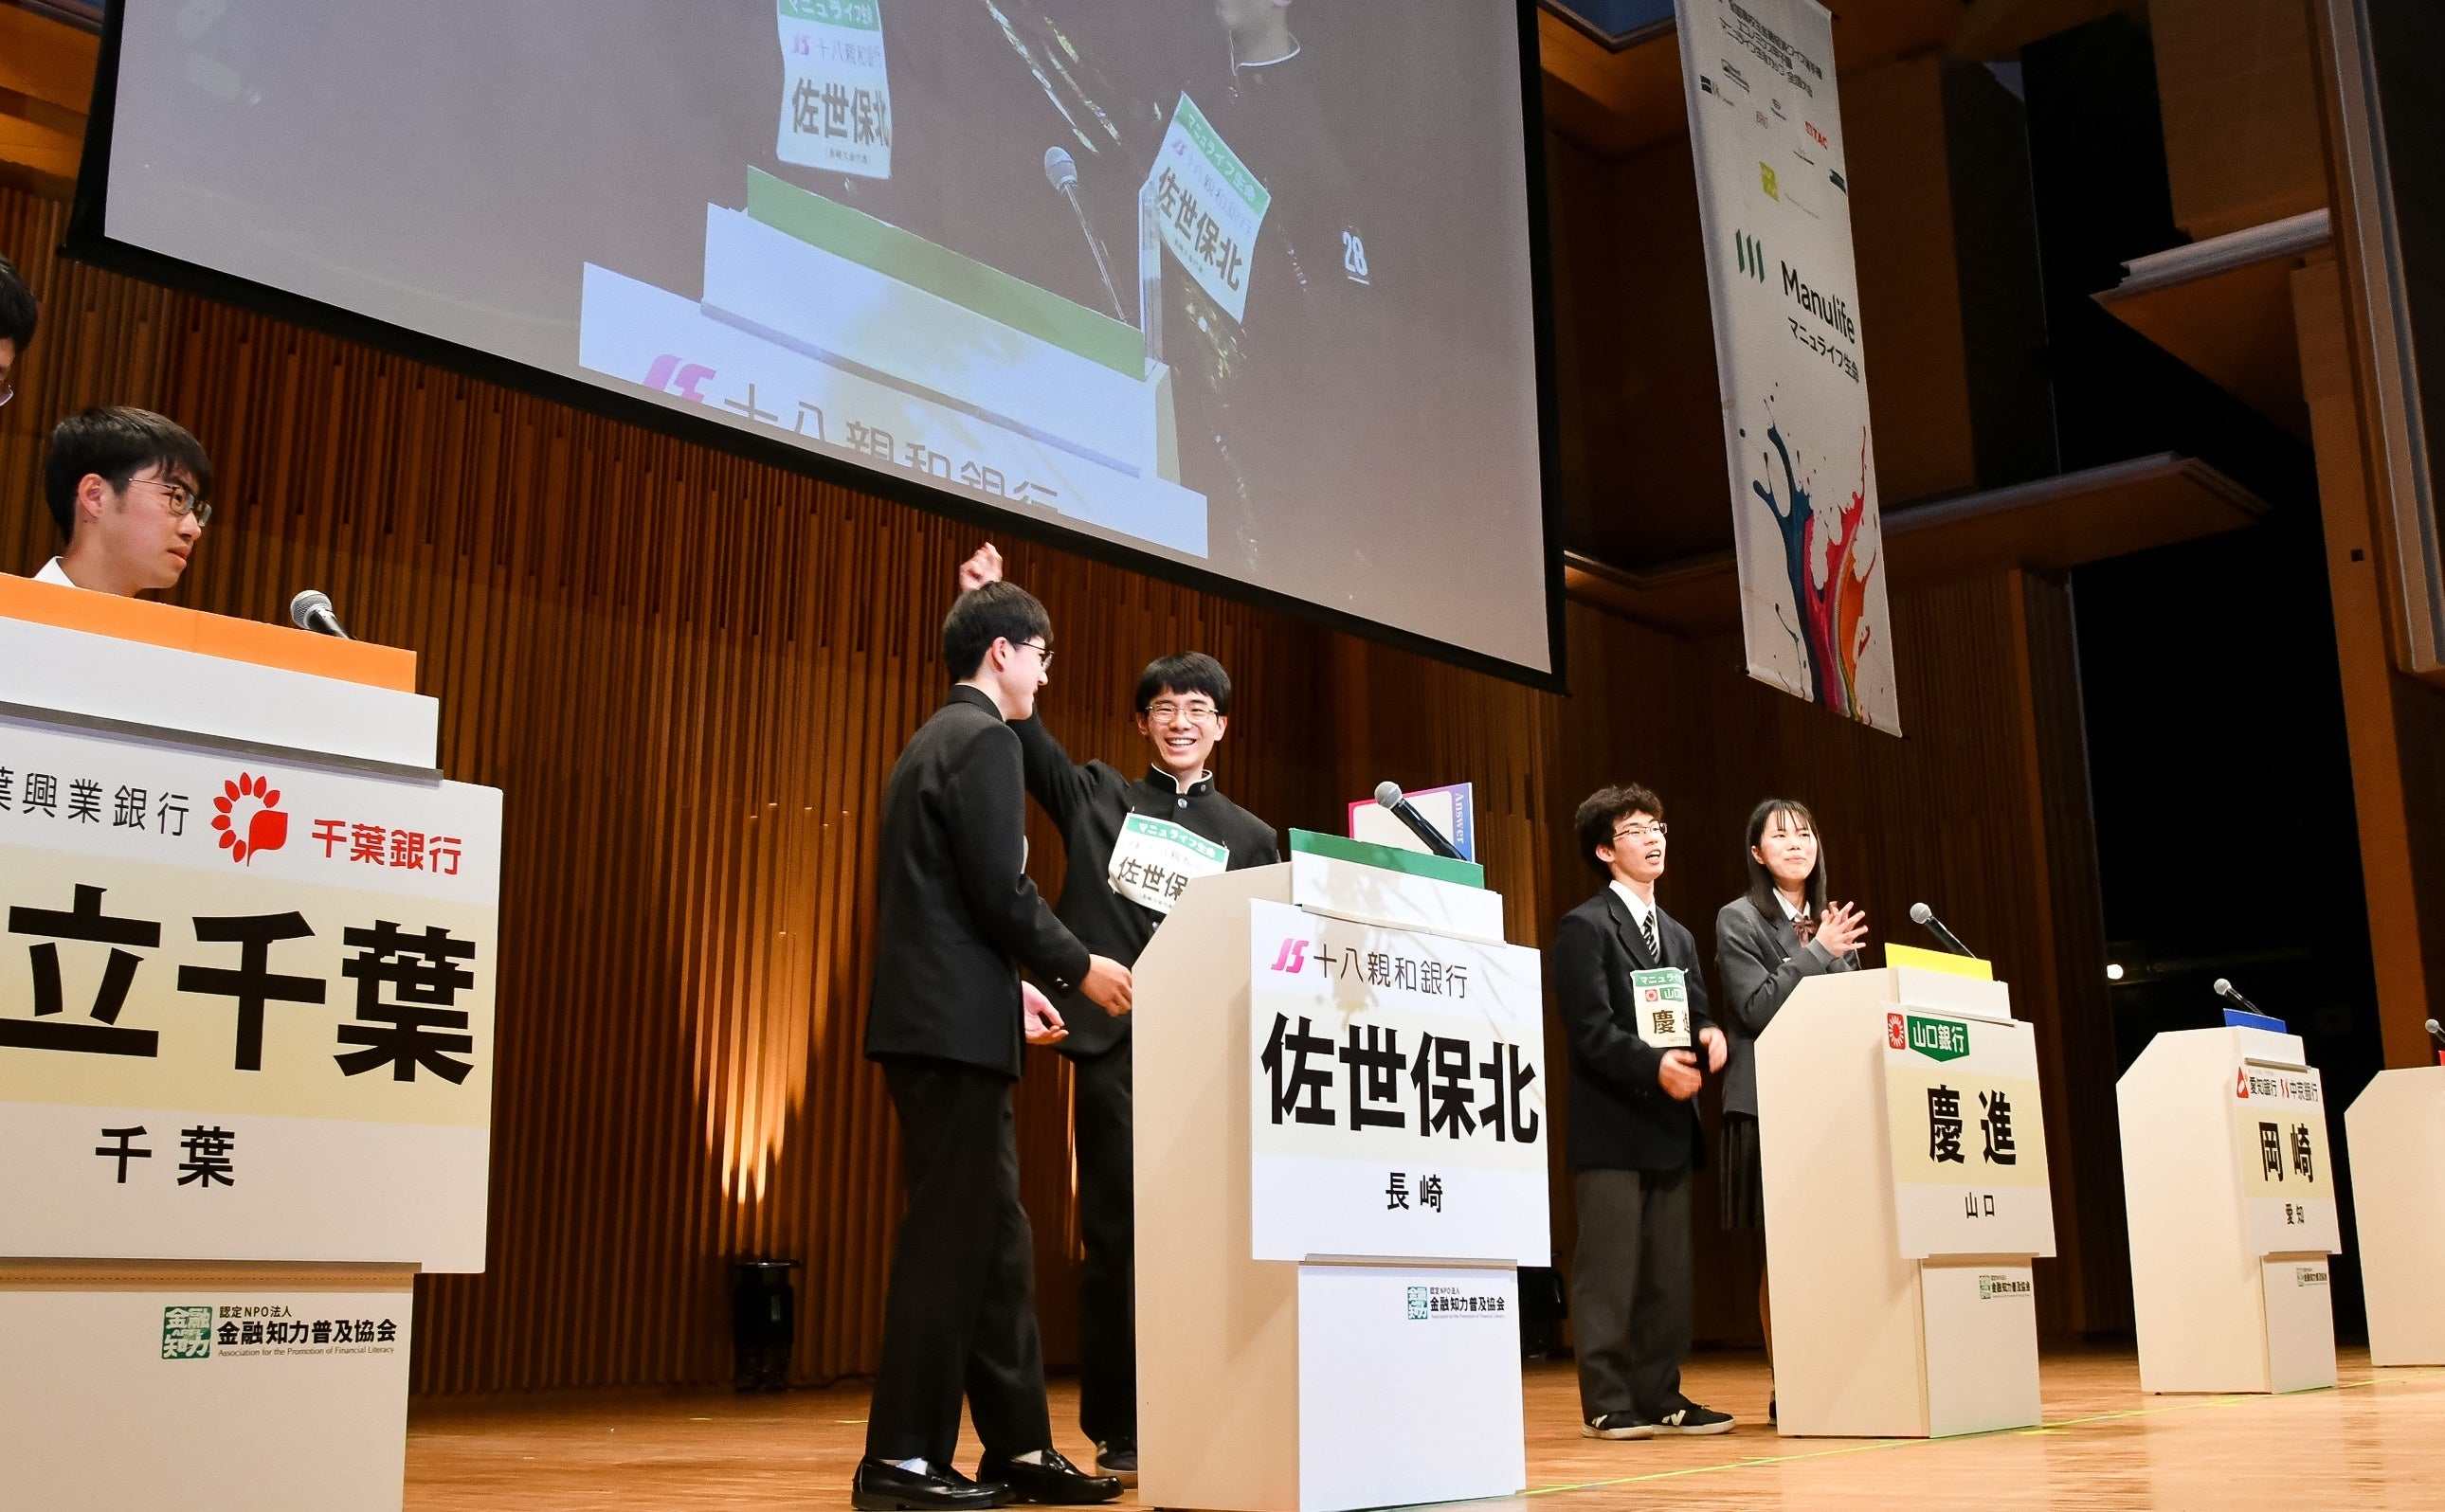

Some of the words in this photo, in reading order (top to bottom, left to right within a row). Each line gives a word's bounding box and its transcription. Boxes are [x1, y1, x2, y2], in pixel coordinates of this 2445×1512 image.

[792, 77, 891, 147] 佐世保北
[1187, 112, 1257, 202] マニュライフ生命
[1158, 166, 1242, 292] 佐世保北
[1342, 231, 1368, 276] 28
[1781, 260, 1856, 344] Manulife
[1137, 821, 1217, 859] マニュライフ生命
[1454, 792, 1465, 844] Answer
[311, 818, 462, 875] 千葉銀行
[0, 883, 477, 1086] 立千葉
[1313, 944, 1469, 999] 十八親和銀行
[1912, 1020, 1965, 1054] 山口銀行
[1261, 1011, 1540, 1144] 佐世保北
[1927, 1084, 2017, 1165] 慶進
[2257, 1121, 2314, 1183] 岡崎
[95, 1125, 236, 1188] 千葉
[1385, 1171, 1444, 1214] 長崎
[1964, 1191, 1996, 1219] 山口
[217, 1318, 398, 1345] 金融知力普及協会
[219, 1305, 293, 1319] 認定NPO法人
[1429, 1296, 1505, 1312] 金融知力普及協会
